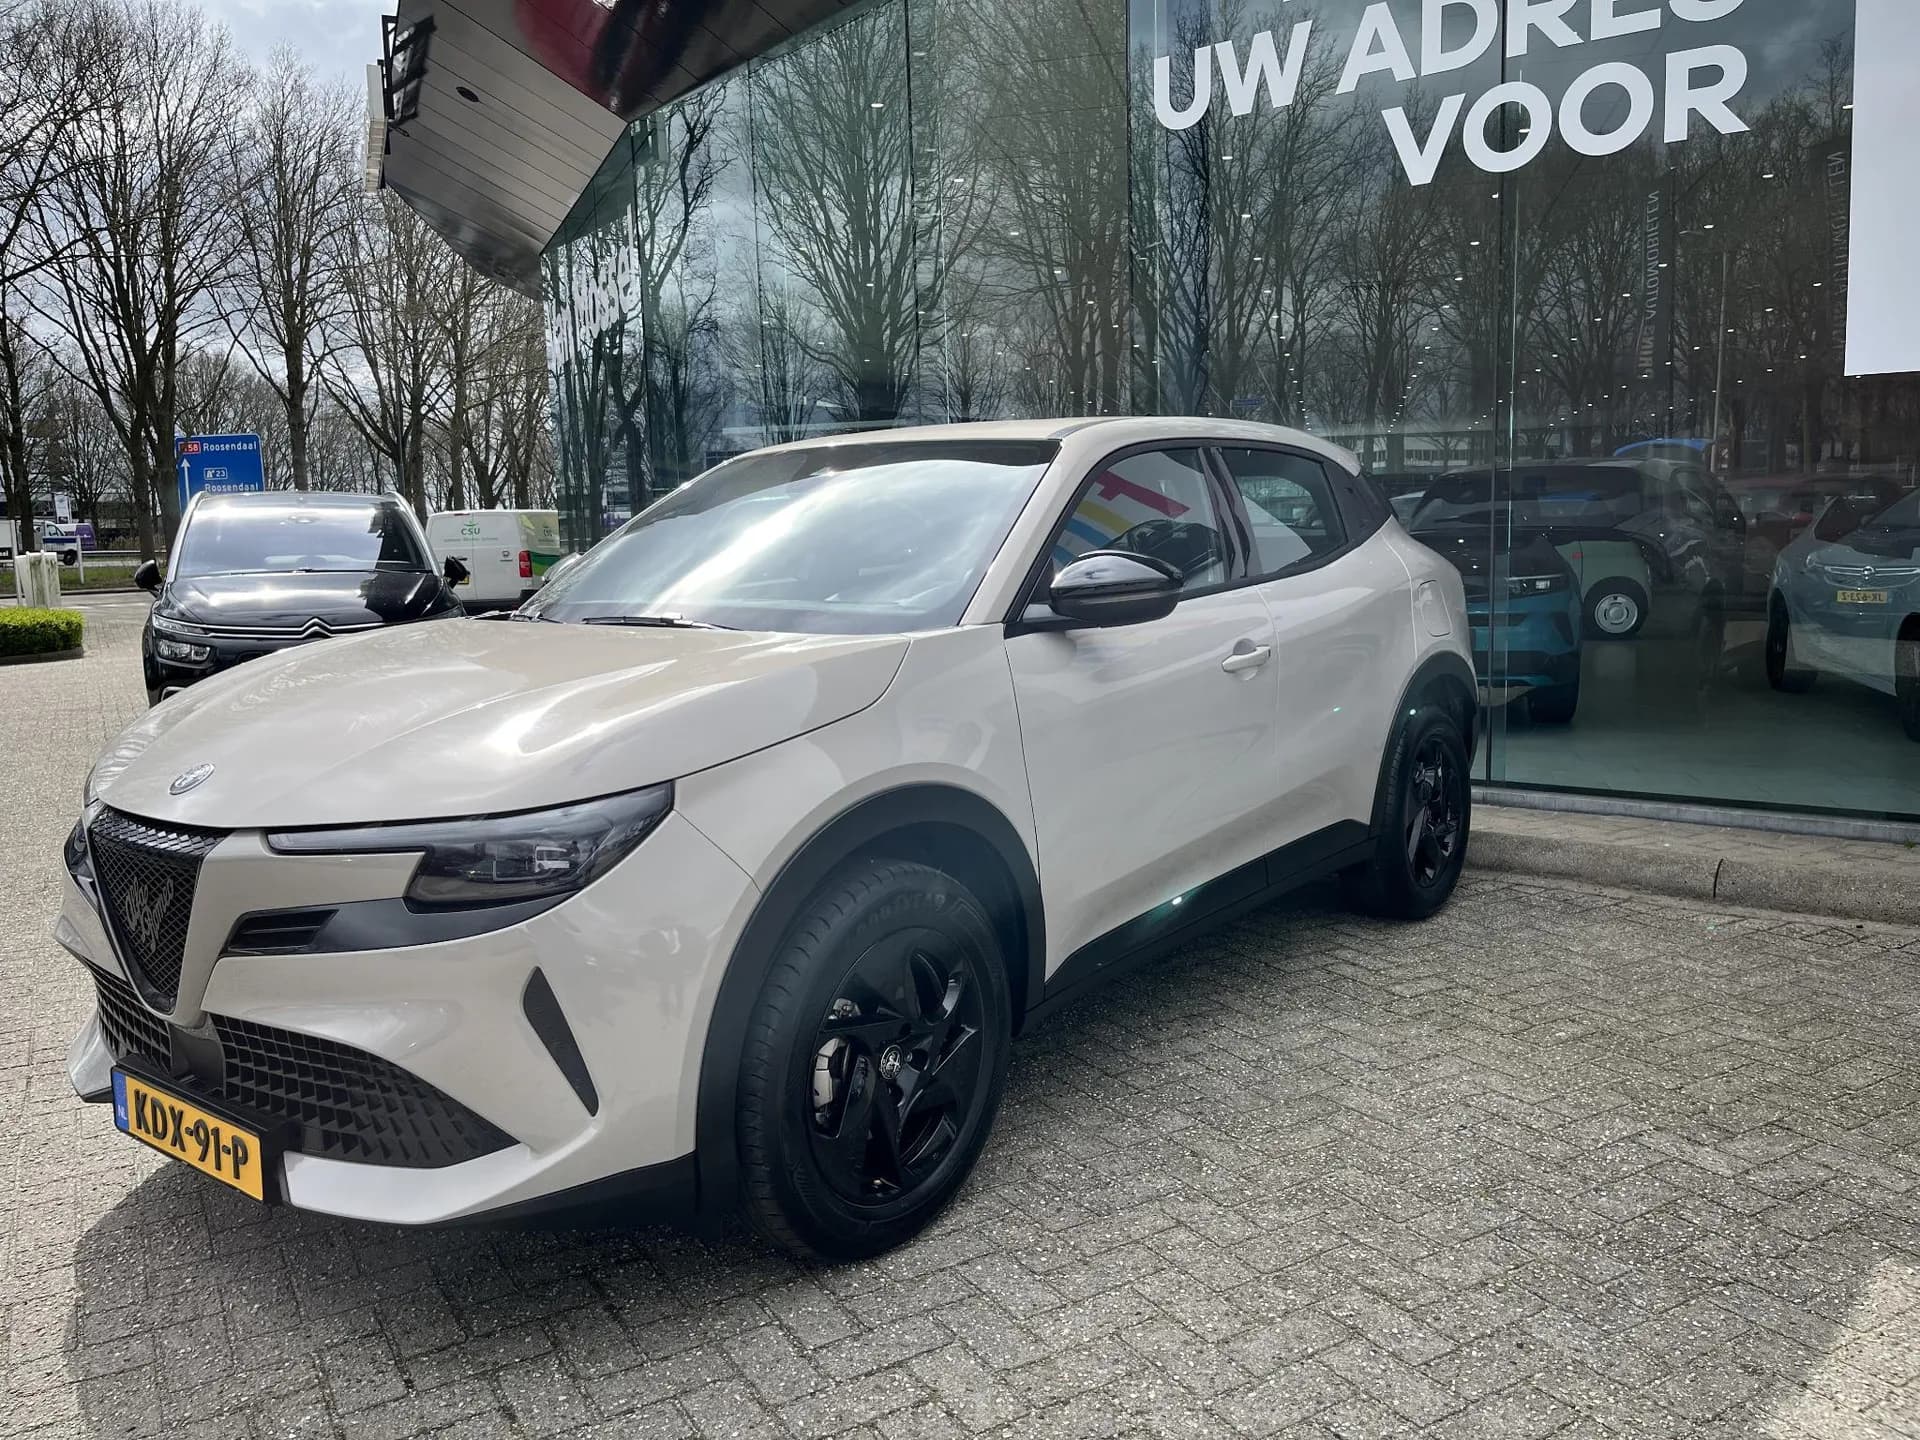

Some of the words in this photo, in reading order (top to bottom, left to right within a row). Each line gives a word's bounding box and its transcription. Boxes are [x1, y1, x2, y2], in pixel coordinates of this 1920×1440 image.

[1154, 20, 1312, 130] UW
[1335, 0, 1744, 95] ADR
[1381, 44, 1750, 186] VOOR
[182, 443, 198, 453] 58
[203, 441, 257, 452] Roosendaal
[205, 482, 259, 492] Roosendaal
[461, 528, 480, 536] CSU
[117, 1104, 128, 1121] NL
[134, 1088, 249, 1180] KDX-91-P
